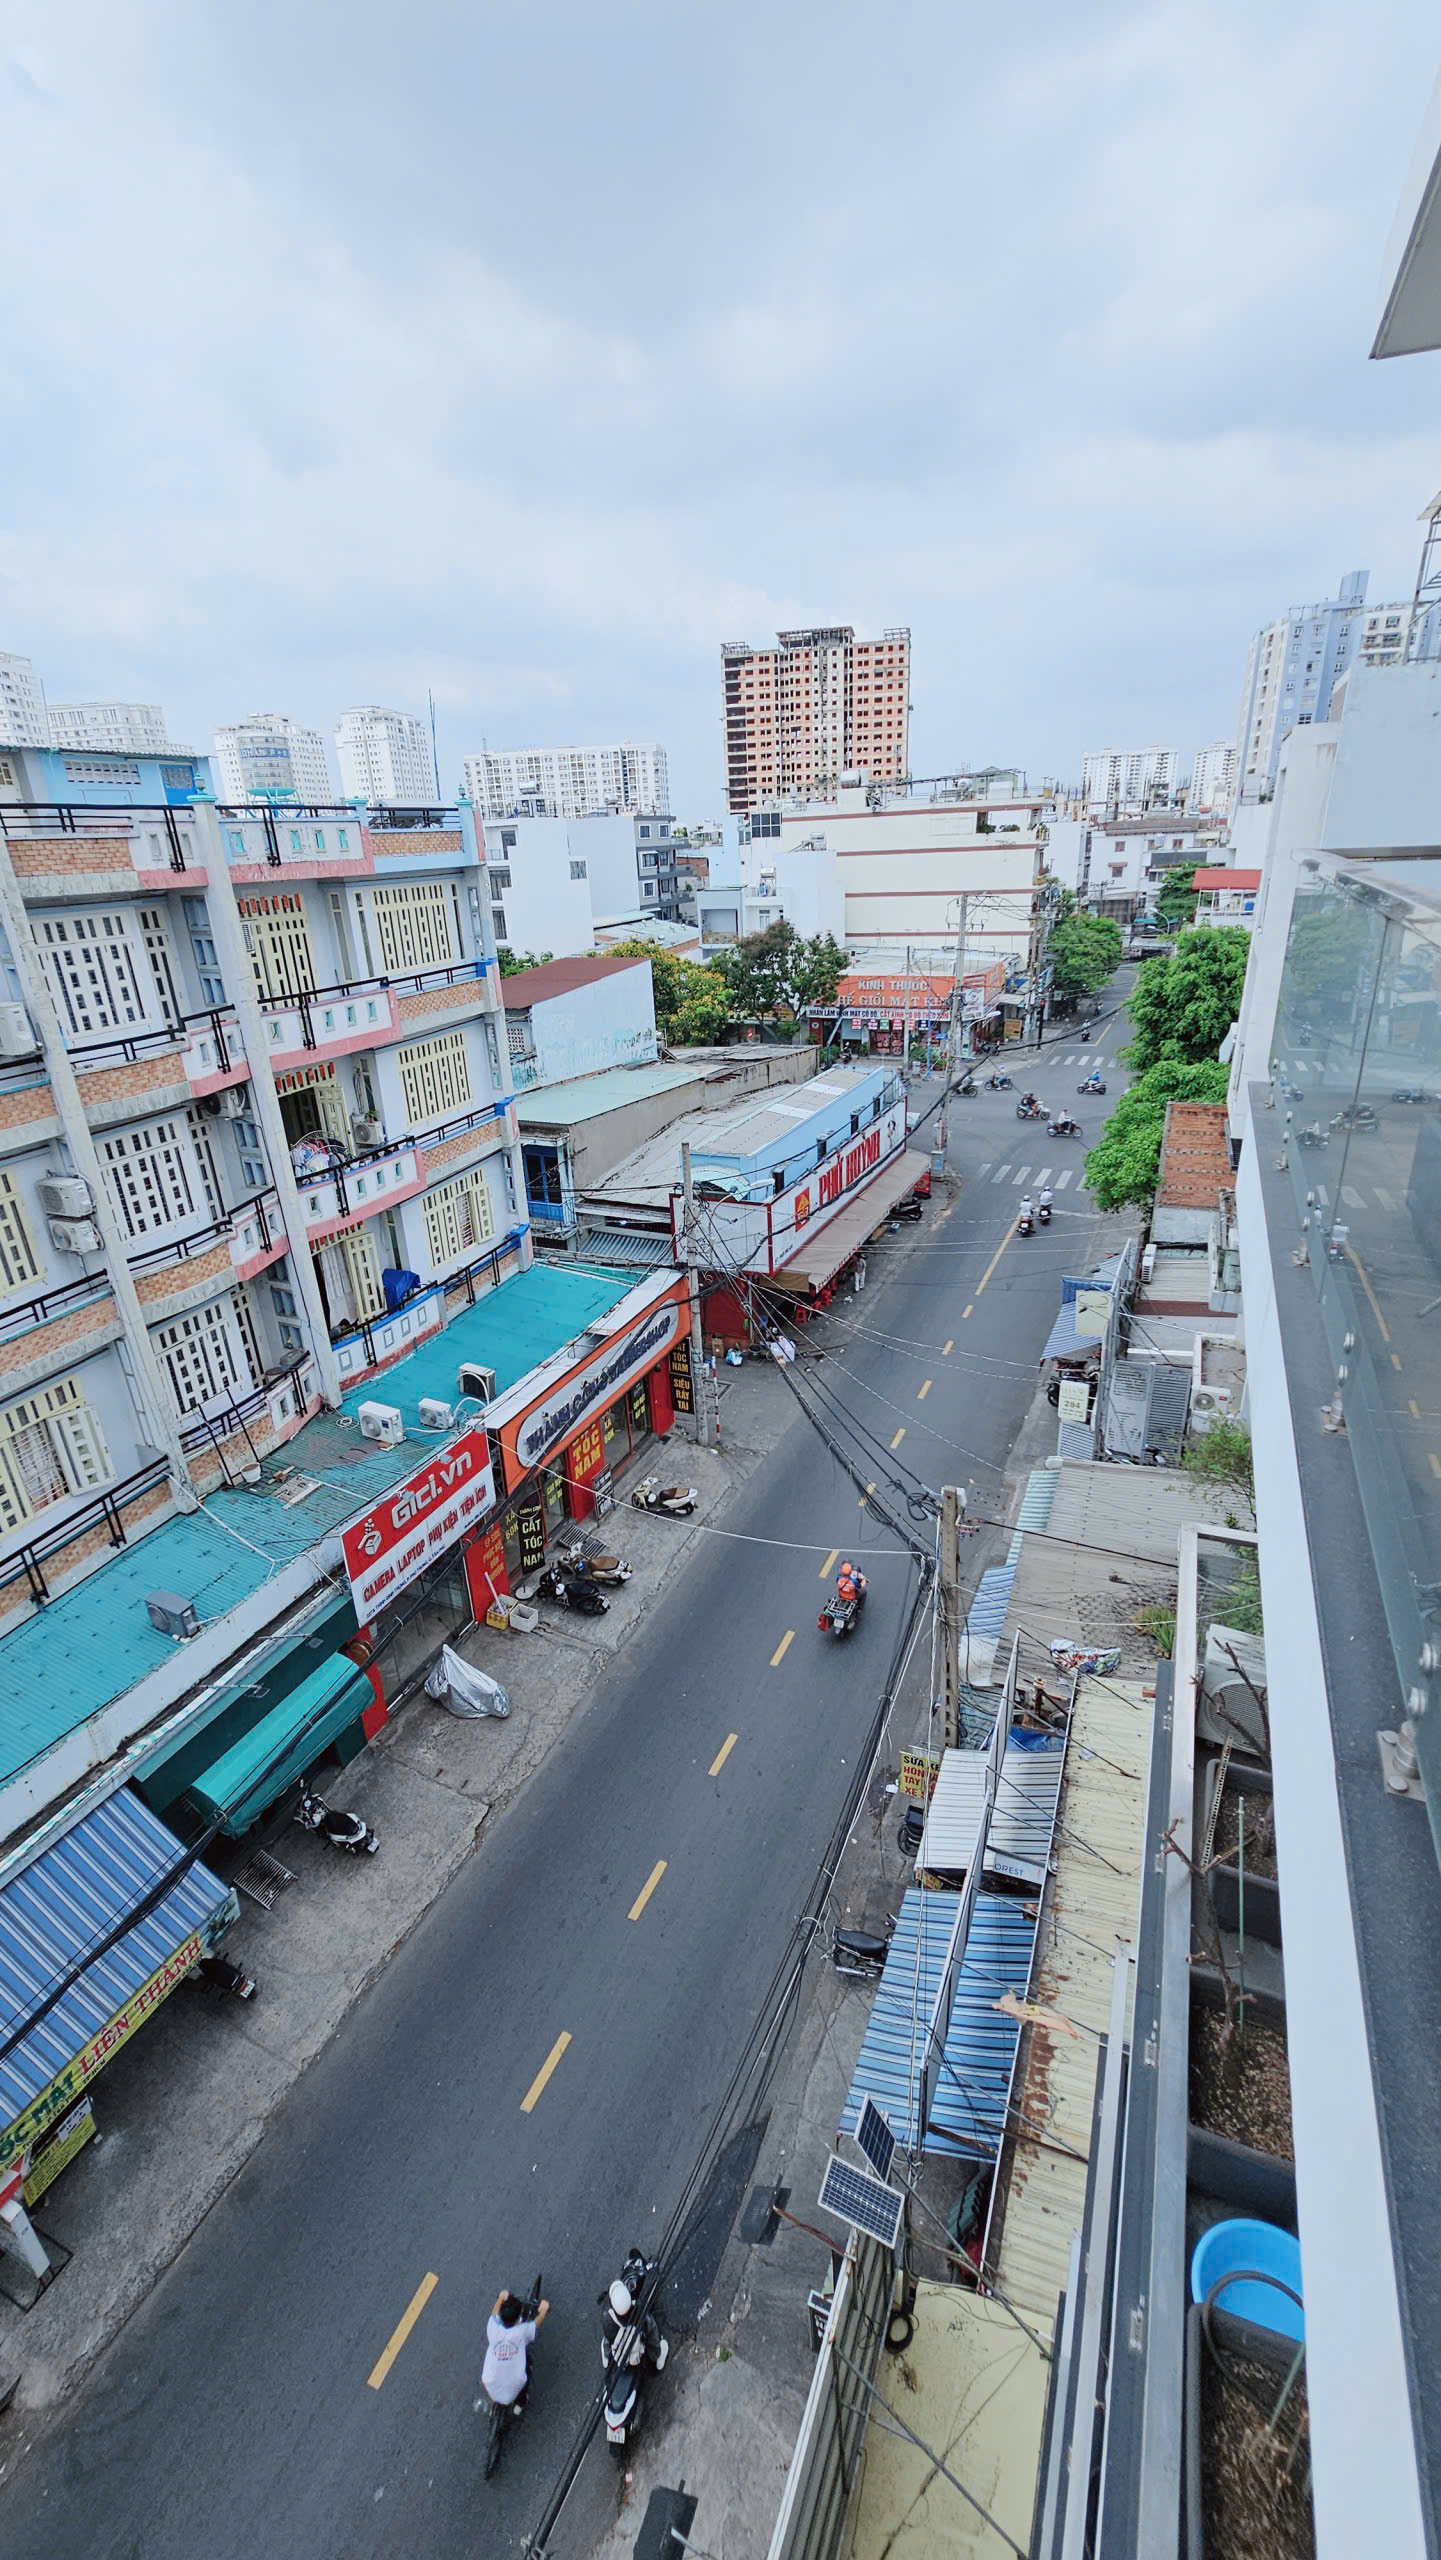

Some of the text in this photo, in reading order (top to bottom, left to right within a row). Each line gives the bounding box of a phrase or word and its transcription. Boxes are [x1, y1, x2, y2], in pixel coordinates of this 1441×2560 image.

[672, 1362, 689, 1373] NAM
[1064, 1400, 1081, 1409] 284
[573, 1428, 600, 1462] TÓC
[574, 1444, 601, 1480] NAM
[522, 1518, 541, 1534] CẮT
[362, 1566, 396, 1602] CAMERA
[397, 1539, 426, 1574] LAPTOP
[427, 1523, 442, 1547] PHỤ
[474, 1483, 487, 1506] ÍCH
[523, 1536, 543, 1550] TÓC
[904, 1786, 917, 1797] XE
[78, 2012, 131, 2076] LIÊN
[134, 1936, 202, 2015] THÀNH
